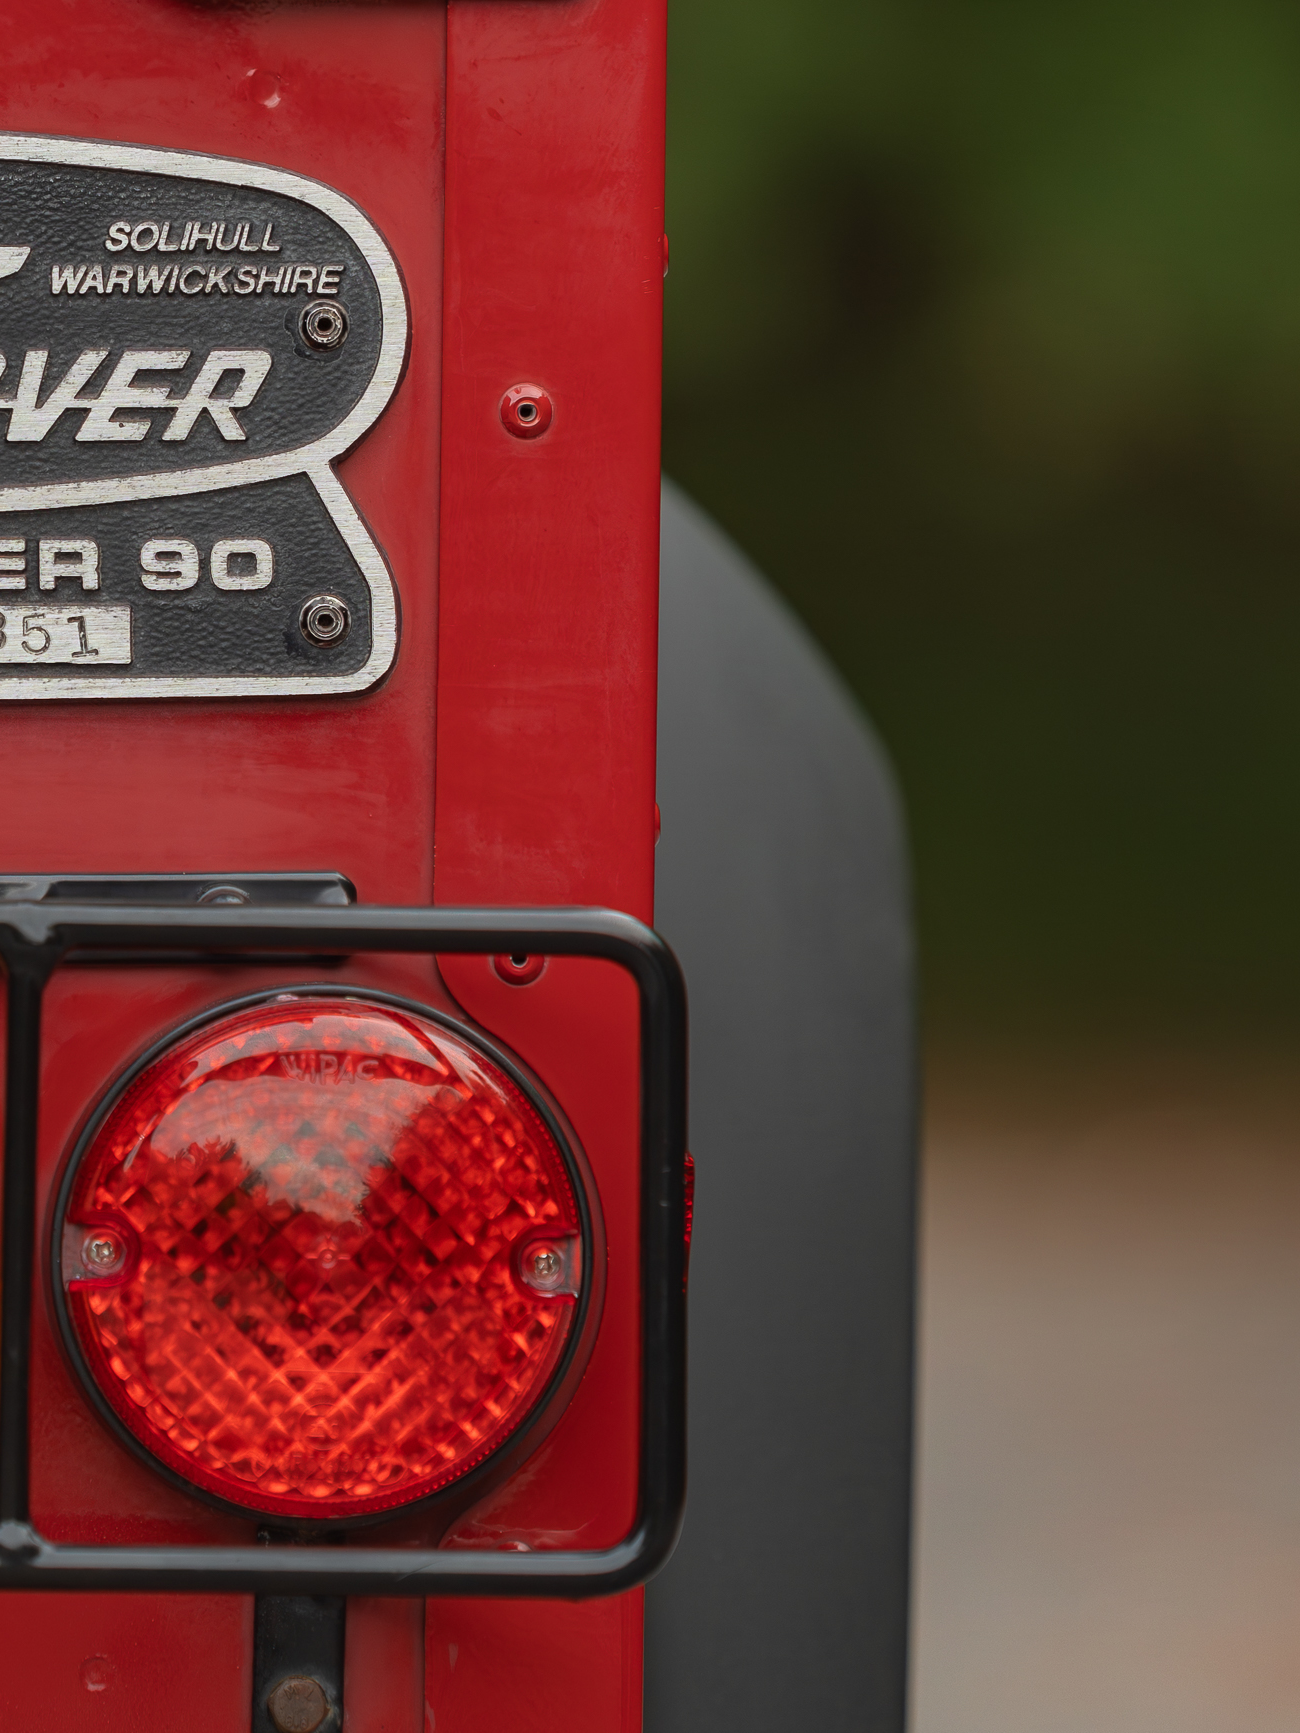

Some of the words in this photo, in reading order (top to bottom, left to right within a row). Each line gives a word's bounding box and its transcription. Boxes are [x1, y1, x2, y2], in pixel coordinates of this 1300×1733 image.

[104, 221, 282, 252] SOLIHULL
[50, 264, 346, 295] WARWICKSHIRE
[140, 537, 274, 592] 90
